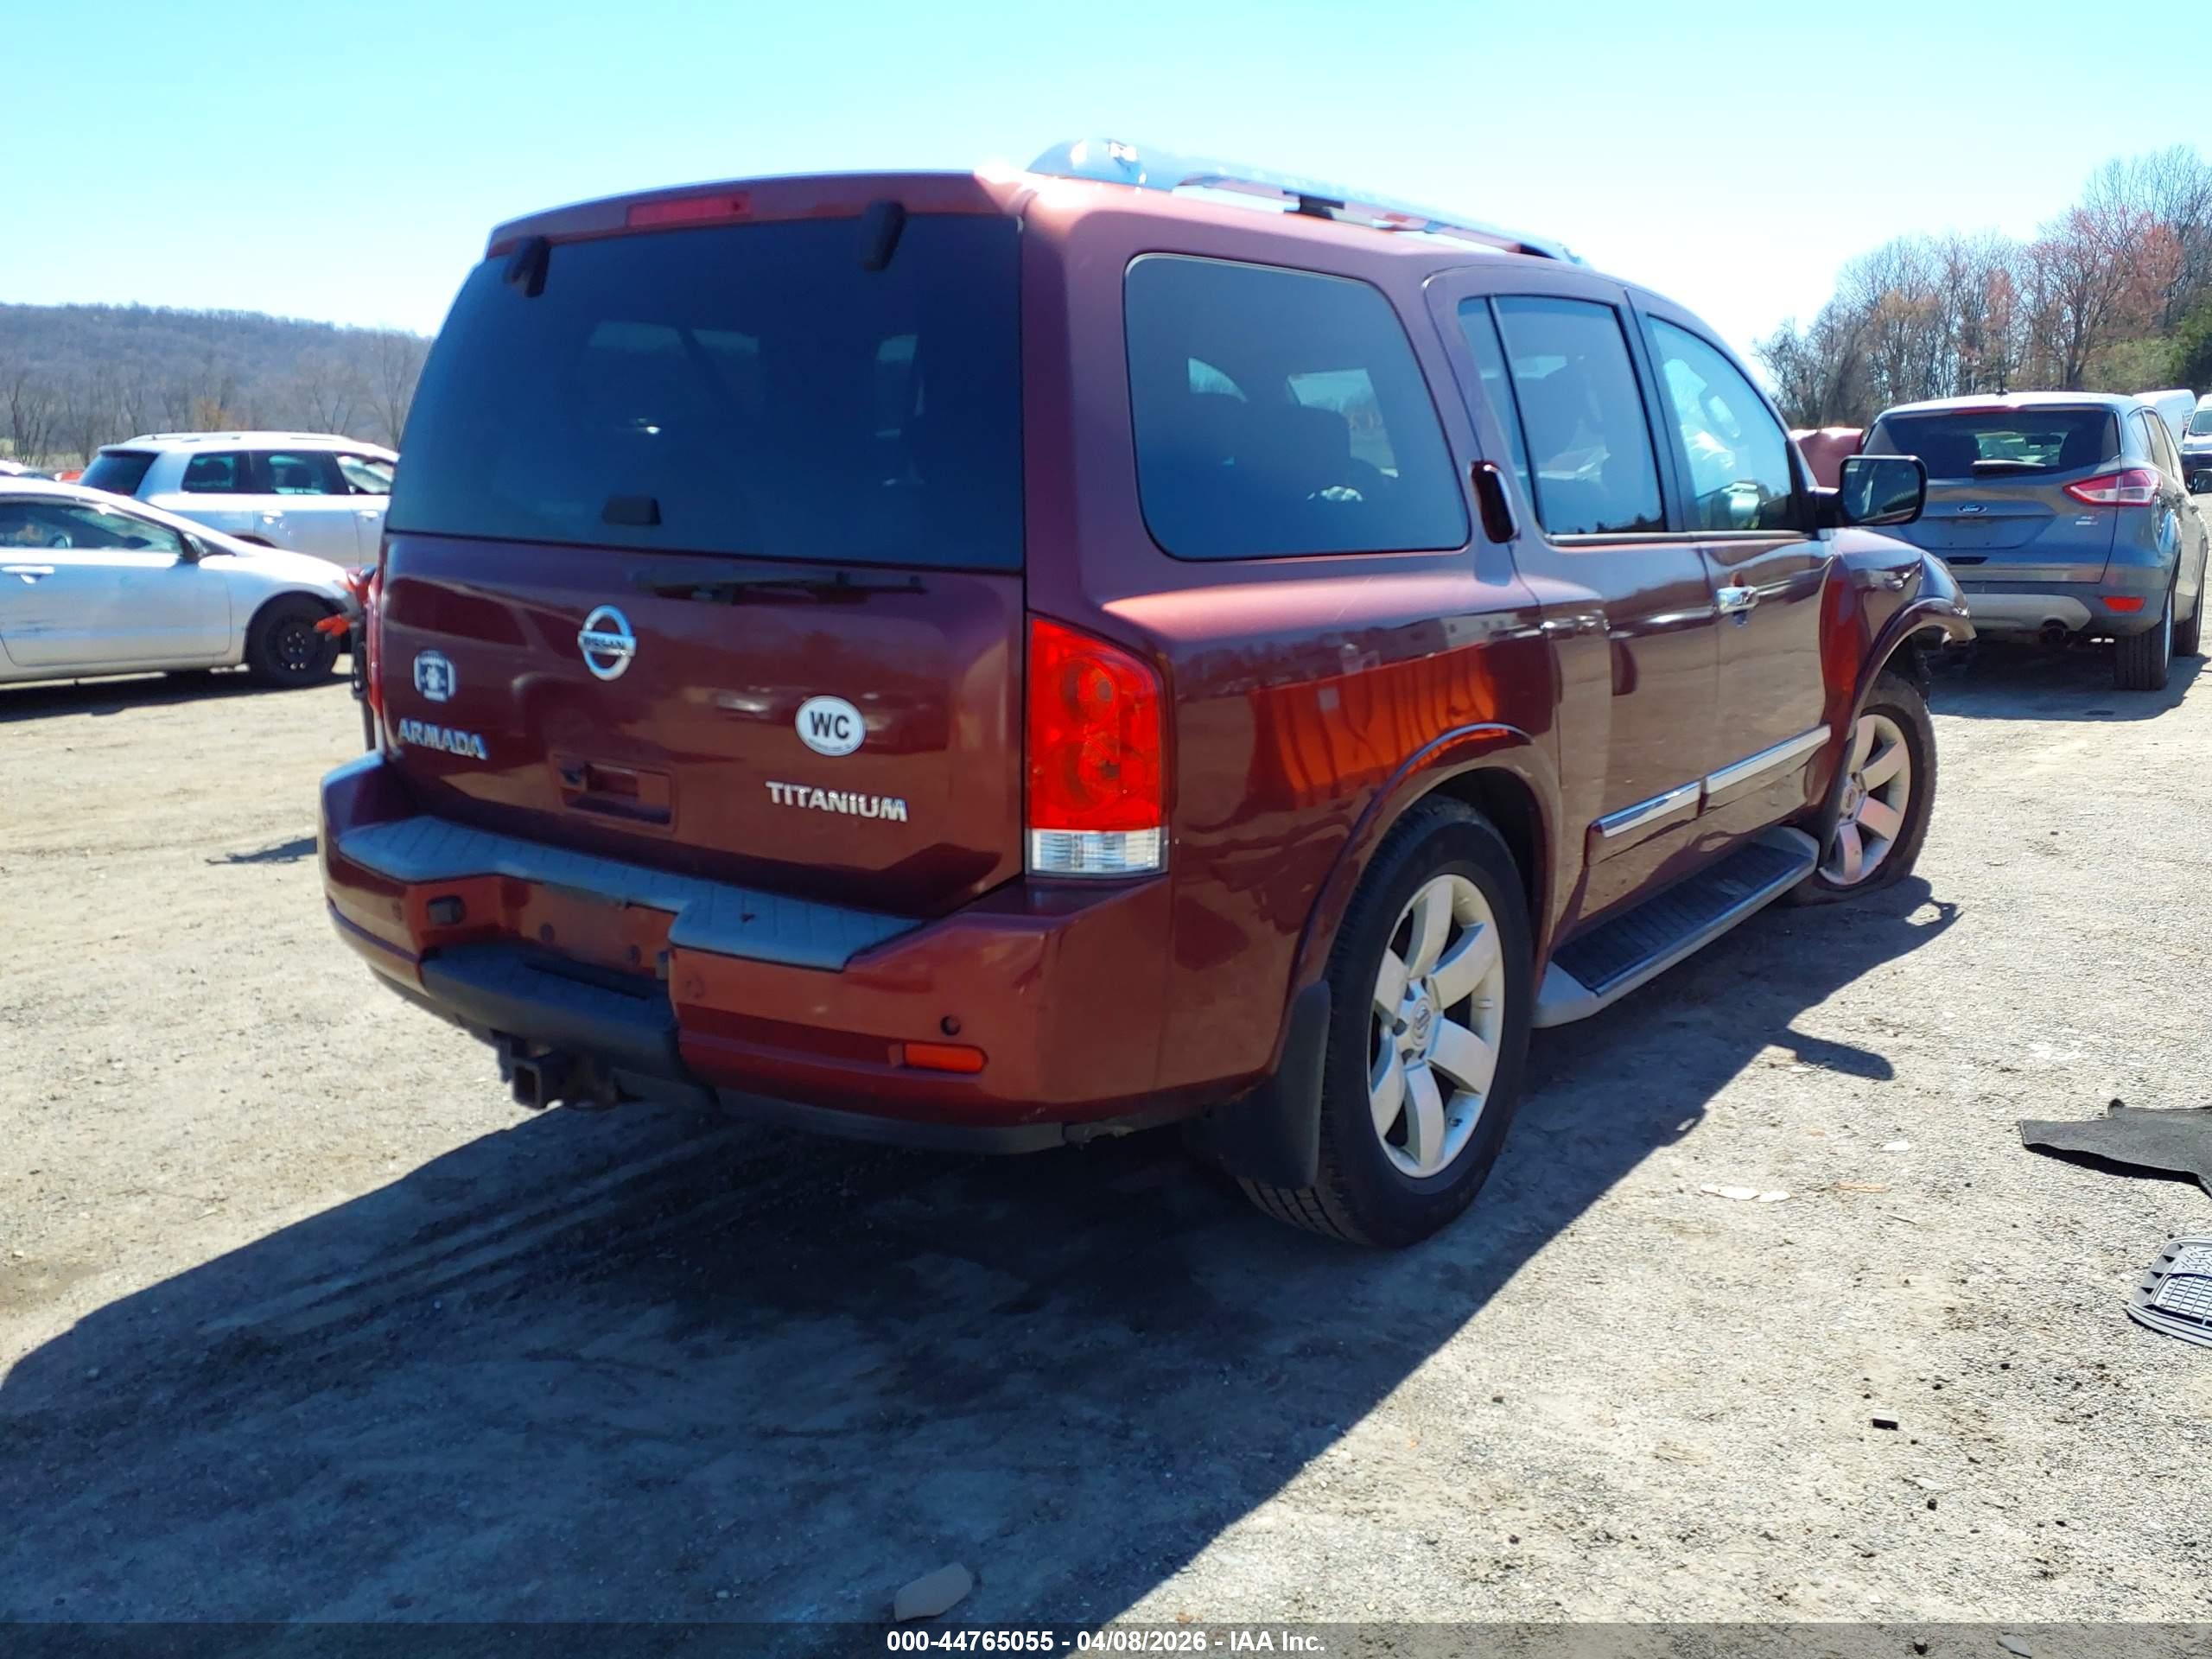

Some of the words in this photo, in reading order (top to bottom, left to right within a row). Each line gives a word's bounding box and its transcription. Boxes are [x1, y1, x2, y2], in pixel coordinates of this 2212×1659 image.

[398, 717, 487, 760] ARMADA
[809, 710, 850, 740] WC
[765, 780, 908, 823] TITANIUM
